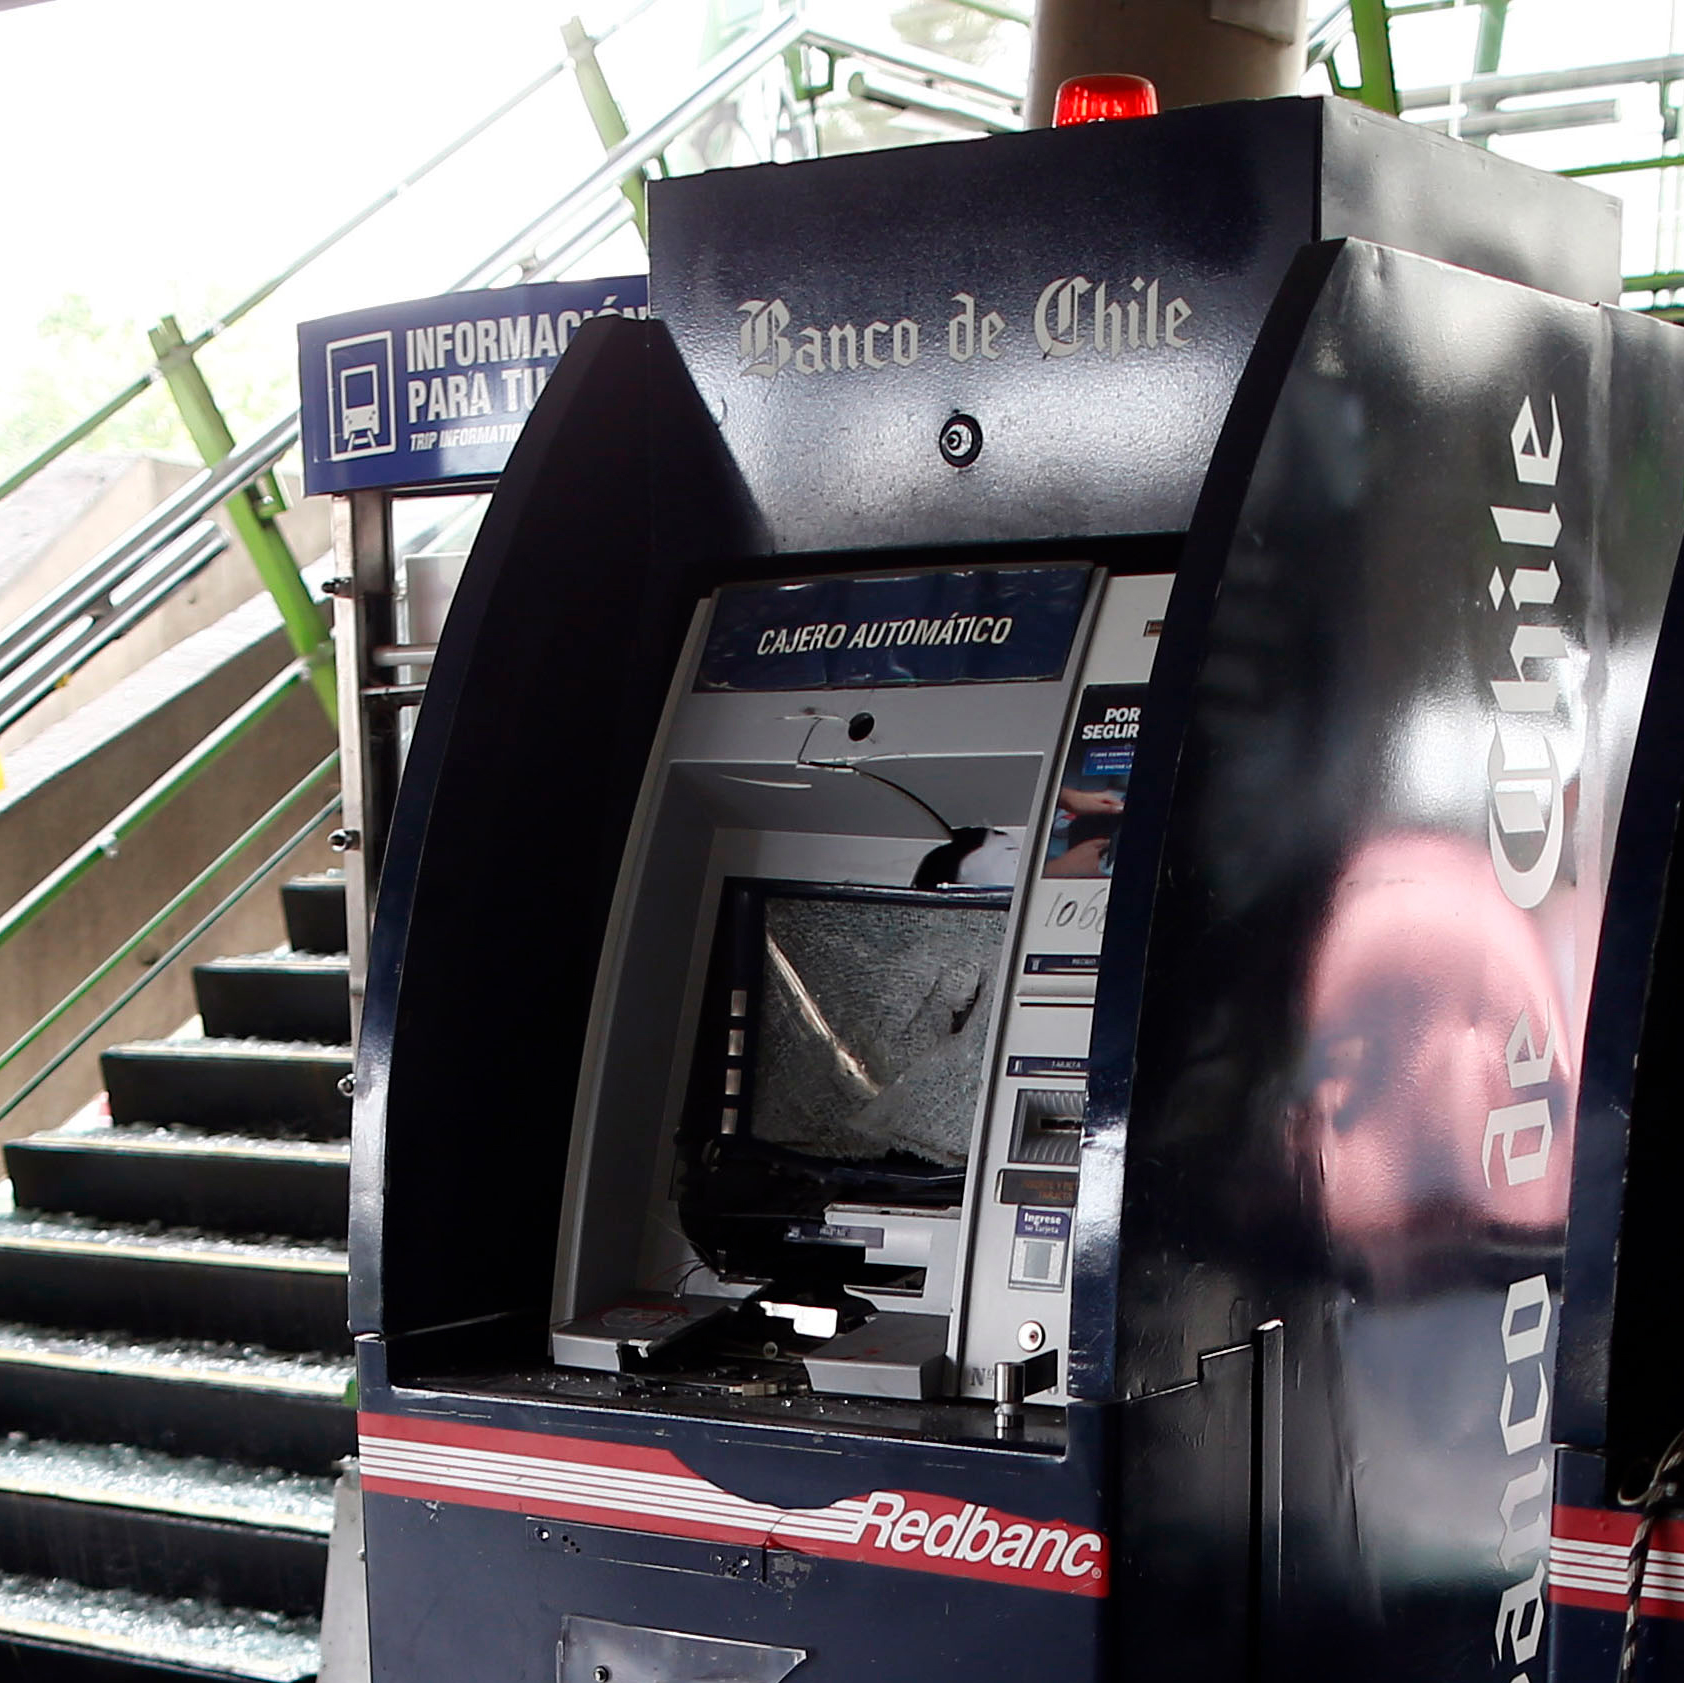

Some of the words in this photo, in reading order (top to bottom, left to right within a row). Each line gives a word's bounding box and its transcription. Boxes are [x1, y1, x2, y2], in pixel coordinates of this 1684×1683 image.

[405, 293, 649, 373] INFORMAC
[735, 297, 919, 379] Banco
[948, 291, 1006, 364] de
[1034, 275, 1194, 361] Chile
[407, 371, 493, 425] PARA
[501, 366, 550, 412] TU
[410, 431, 438, 452] TRIP
[438, 421, 525, 449] INFORMATIO
[756, 623, 847, 656] CAJERO
[847, 611, 1014, 649] AUTOMÁTICO
[1487, 392, 1569, 909] Chile
[1081, 723, 1140, 740] SEGUR
[1103, 706, 1141, 723] POR
[1480, 996, 1556, 1188] de
[1024, 1212, 1062, 1225] Ingrese
[857, 1490, 1103, 1578] Redbanc
